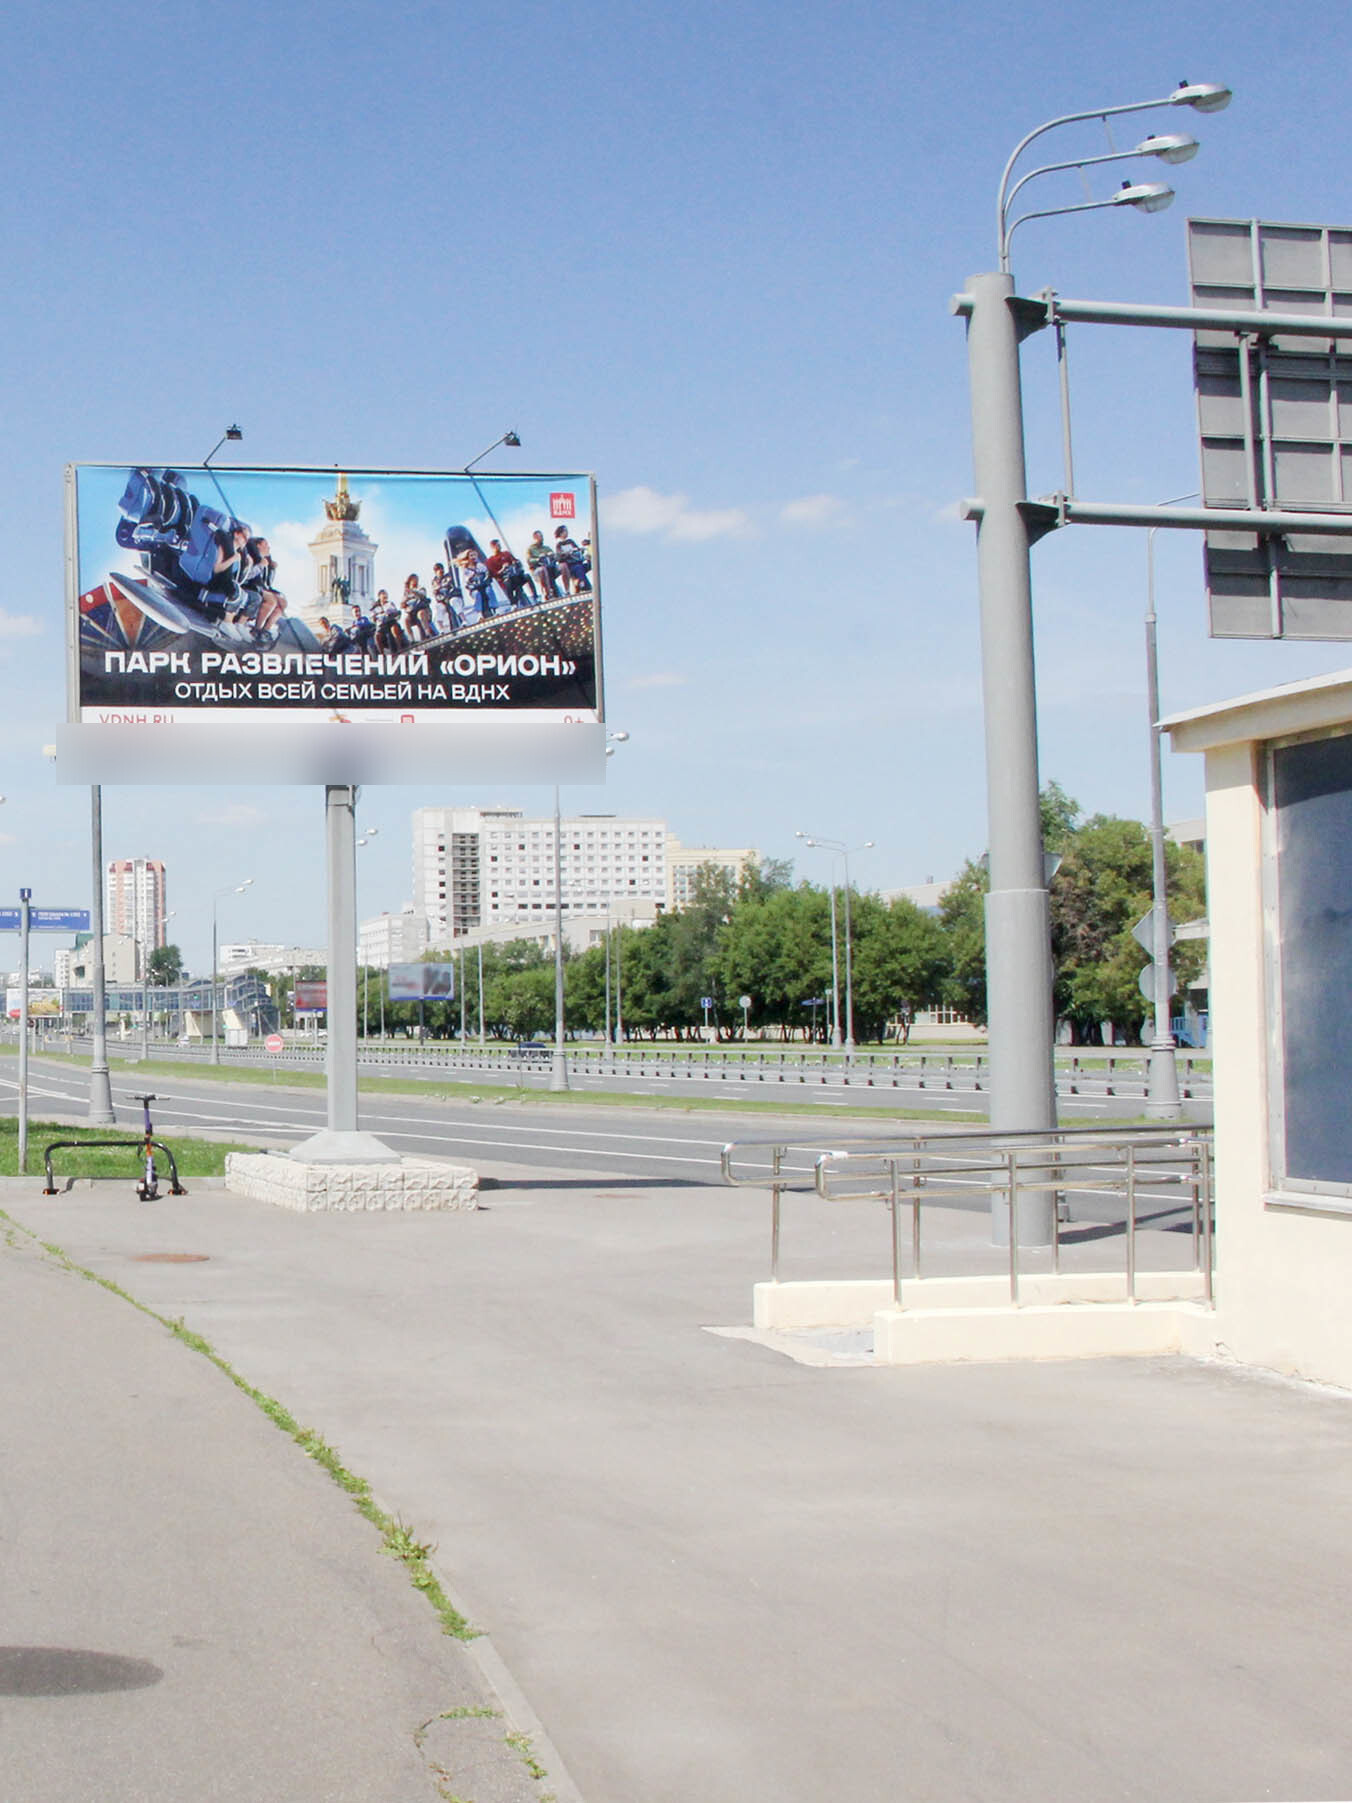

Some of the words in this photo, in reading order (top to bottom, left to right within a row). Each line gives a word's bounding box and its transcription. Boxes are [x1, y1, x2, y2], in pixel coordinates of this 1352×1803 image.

[105, 651, 191, 674] ПАРК
[201, 650, 429, 675] РАЗВЛЕЧЕНИЙ
[440, 655, 576, 676] «ОРИОН»
[175, 682, 252, 702] ОТДЫХ
[258, 681, 316, 699] ВСЕЙ
[321, 681, 412, 700] СЕМЬЕЙ
[418, 684, 447, 700] НА
[452, 684, 510, 702] ВДНХ
